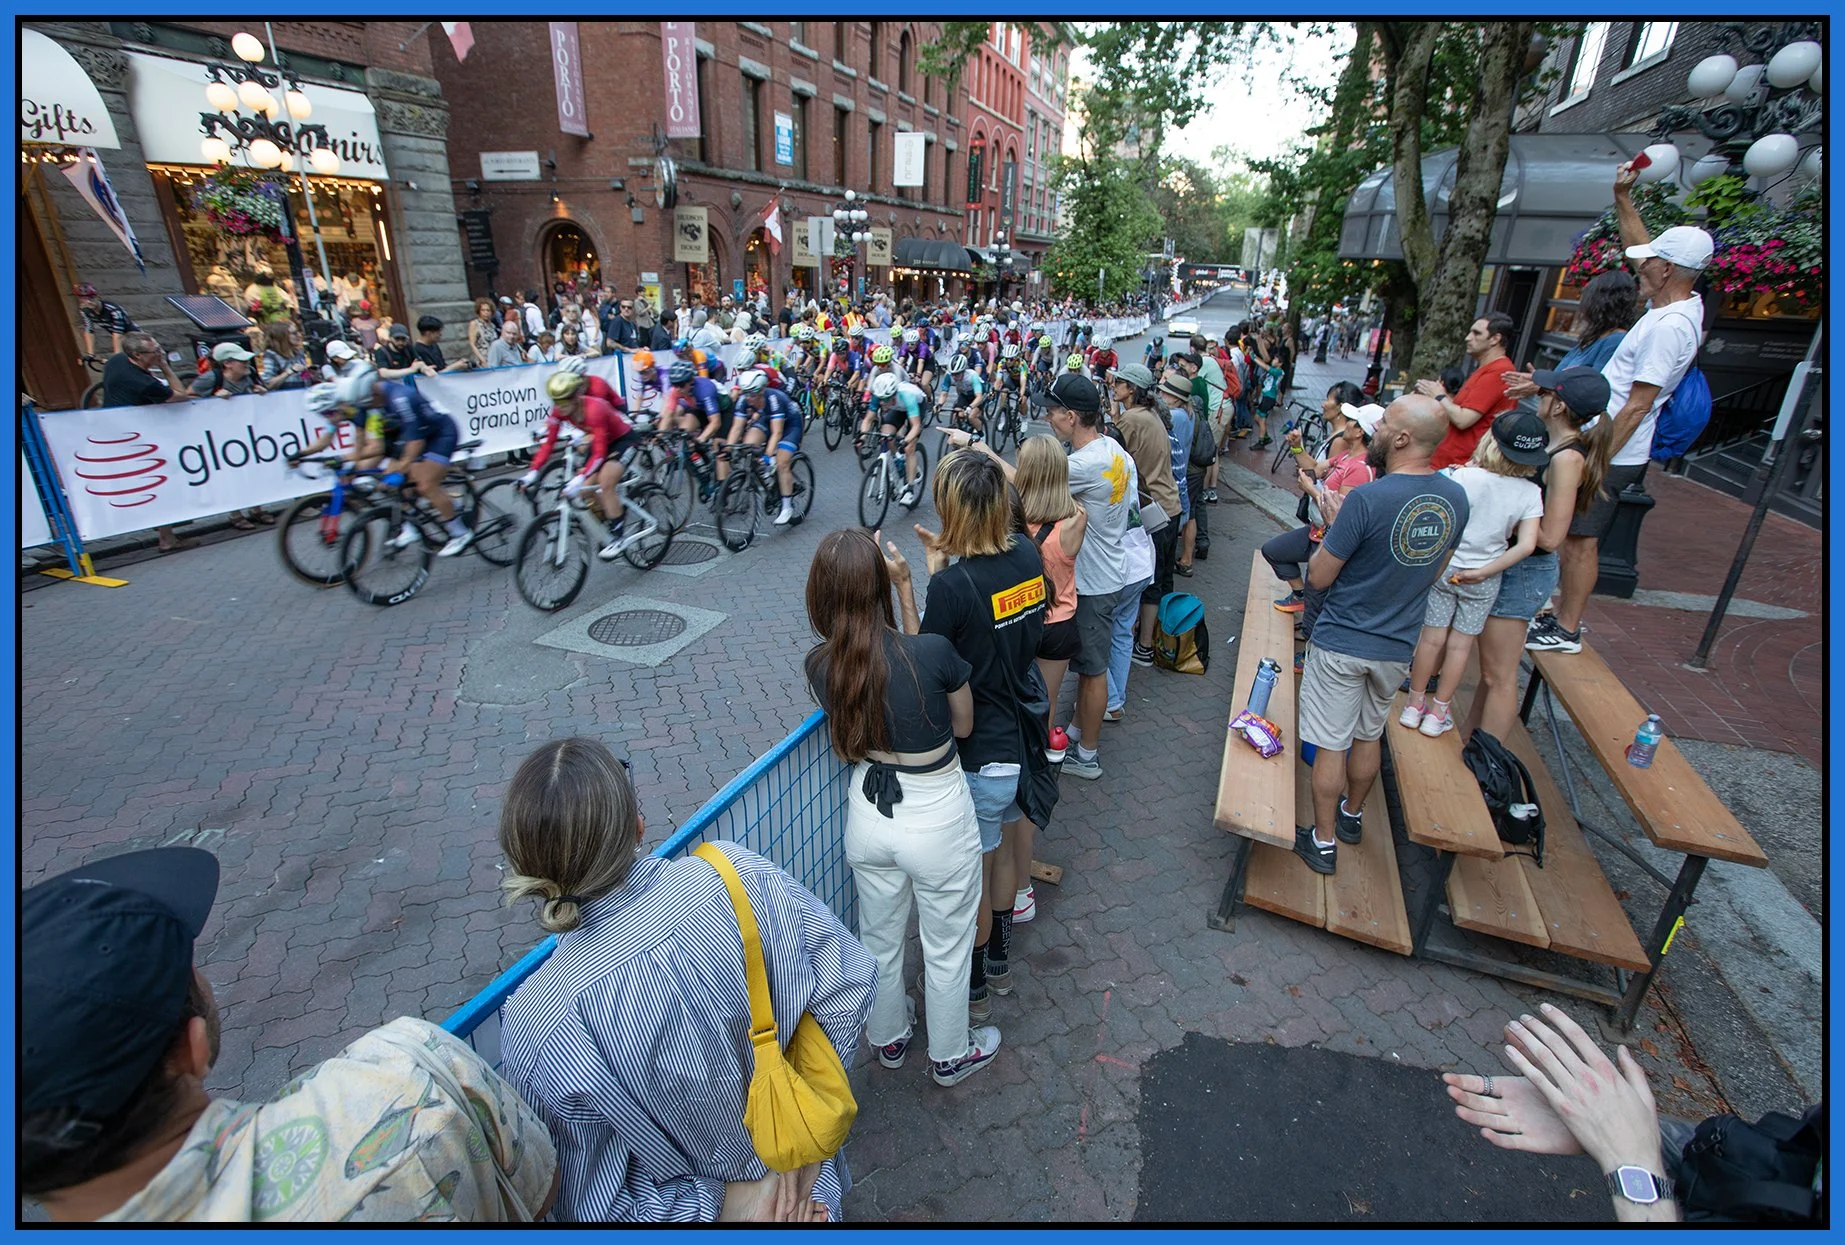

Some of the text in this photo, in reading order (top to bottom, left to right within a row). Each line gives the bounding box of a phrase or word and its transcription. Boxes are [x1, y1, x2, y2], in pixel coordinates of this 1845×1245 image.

[556, 30, 574, 117] PORTO
[667, 37, 684, 122] PORTO
[22, 99, 92, 140] Gifts
[467, 387, 537, 414] gastown
[469, 403, 551, 436] grand prix
[1412, 526, 1440, 538] O'NEILL
[998, 582, 1043, 614] PIRELLI
